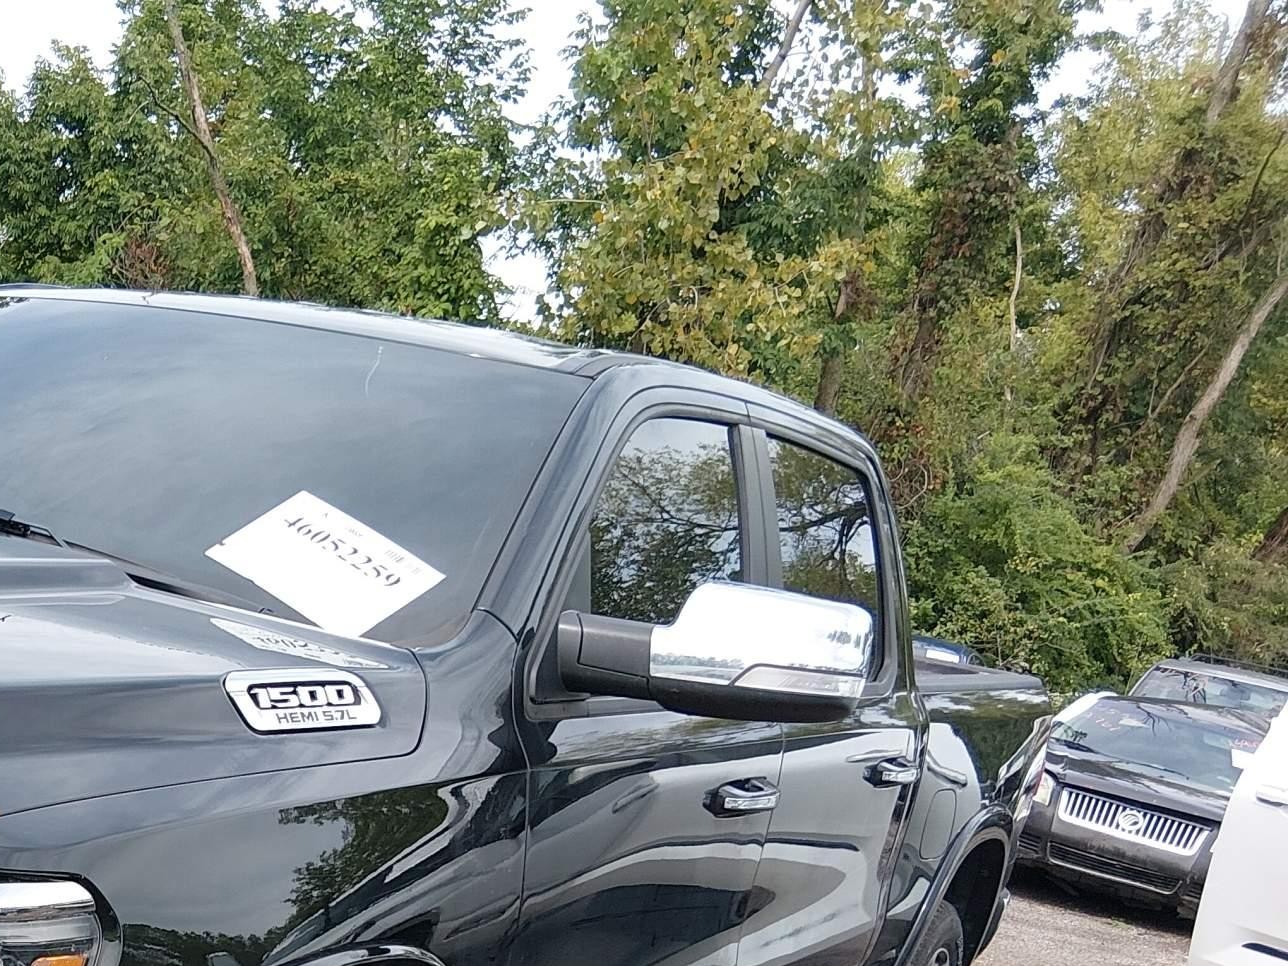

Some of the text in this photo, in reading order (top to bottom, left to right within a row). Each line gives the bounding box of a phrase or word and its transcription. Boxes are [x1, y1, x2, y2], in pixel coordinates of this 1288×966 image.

[284, 516, 401, 587] 46052259
[249, 683, 356, 709] 1500
[275, 708, 358, 724] HEMI 5.7L
